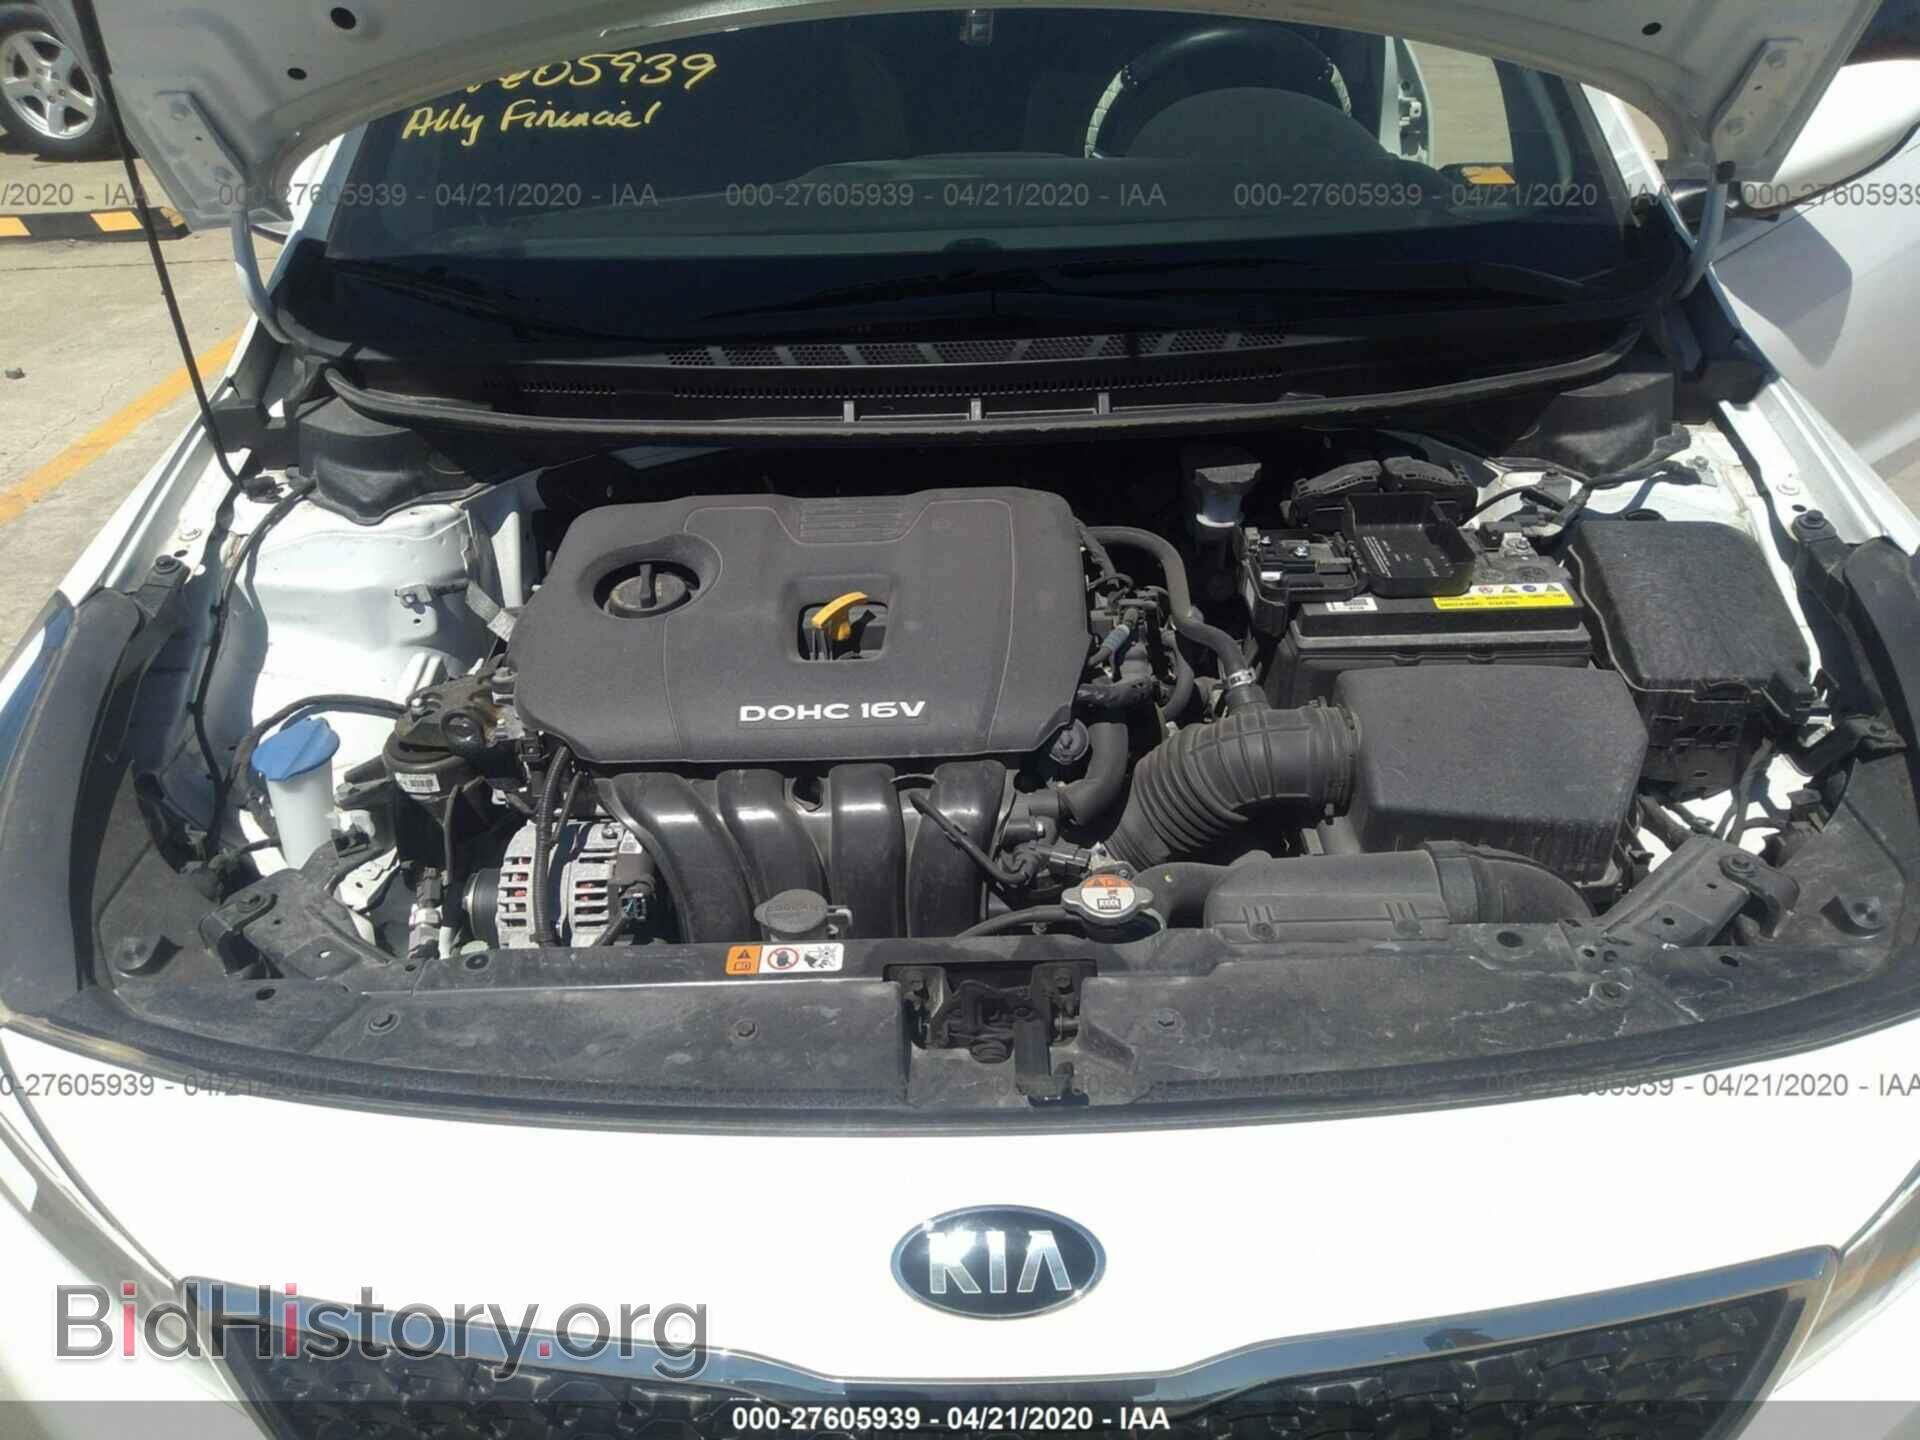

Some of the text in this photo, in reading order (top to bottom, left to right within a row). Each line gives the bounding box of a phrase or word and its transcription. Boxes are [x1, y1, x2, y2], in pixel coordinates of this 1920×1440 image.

[401, 103, 484, 147] Ally
[739, 700, 926, 722] DOHC 16V
[926, 1229, 1073, 1294] KIA
